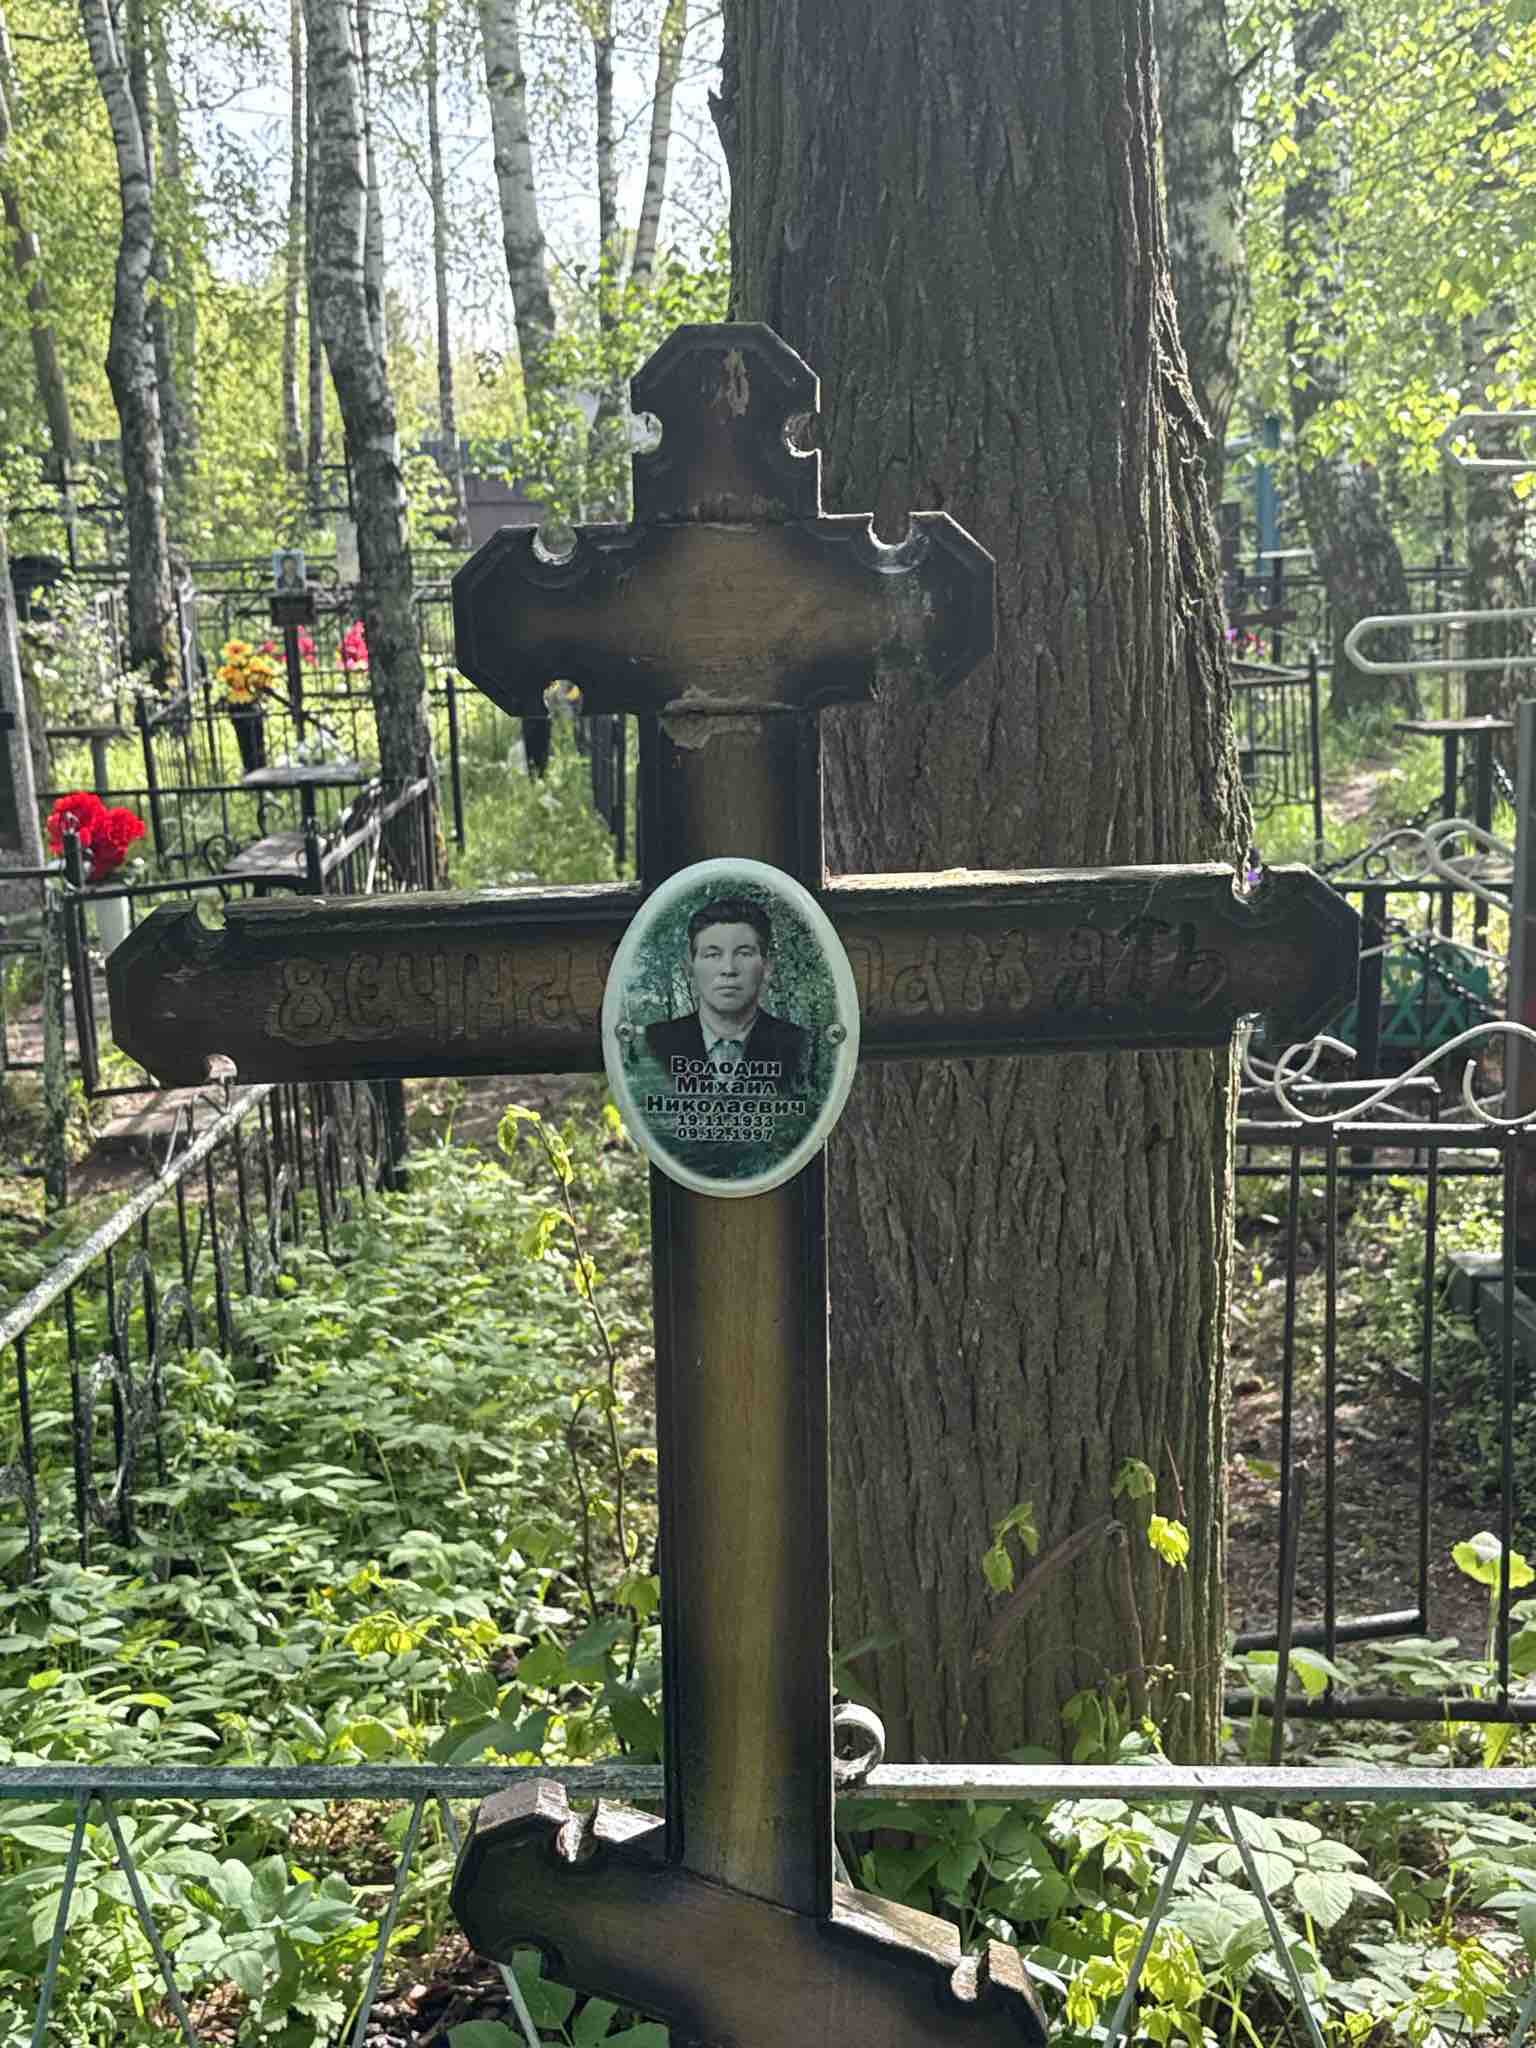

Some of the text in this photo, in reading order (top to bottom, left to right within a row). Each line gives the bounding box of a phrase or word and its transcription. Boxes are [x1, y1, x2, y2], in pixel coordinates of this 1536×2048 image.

[671, 1056, 782, 1077] Володин
[677, 1077, 777, 1096] Михаил
[647, 1095, 807, 1115] Николаевич
[677, 1114, 775, 1128] 19.11.1933
[677, 1127, 774, 1141] 09.12.1997
